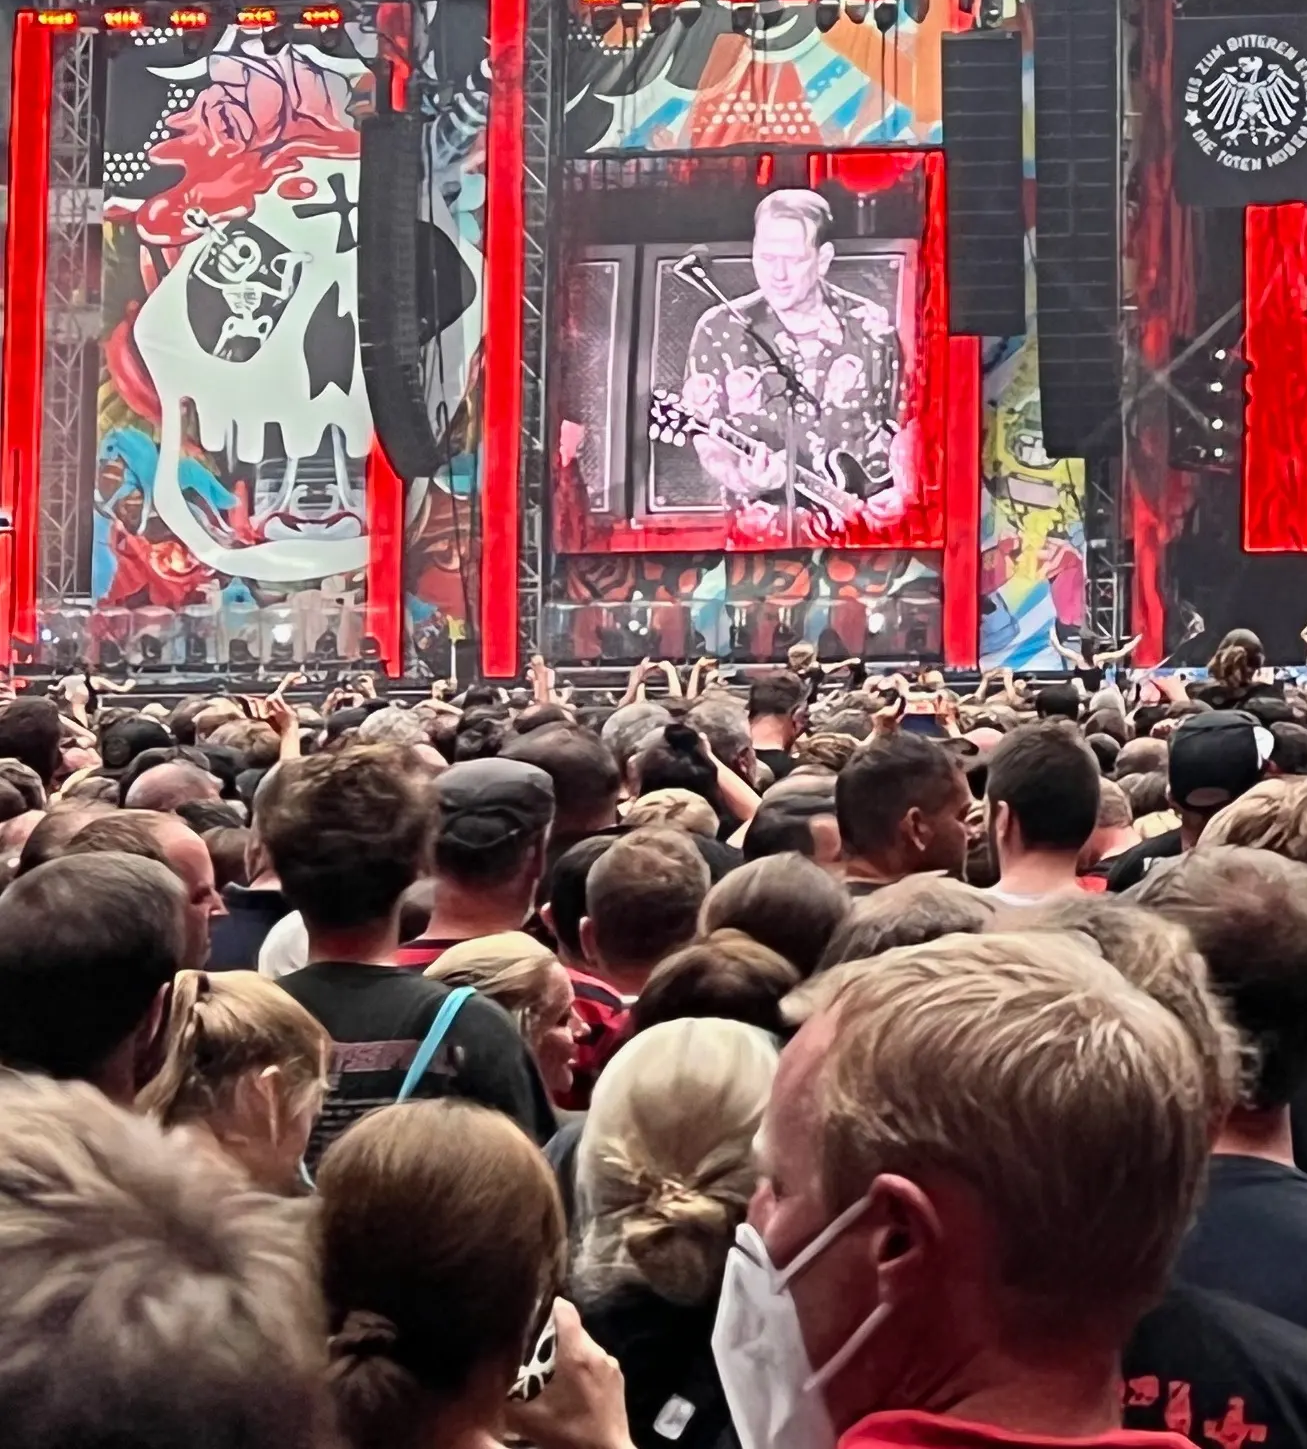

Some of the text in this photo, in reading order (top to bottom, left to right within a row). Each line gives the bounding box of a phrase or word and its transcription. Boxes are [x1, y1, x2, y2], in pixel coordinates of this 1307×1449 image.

[1195, 44, 1226, 75] ZUM
[1192, 129, 1218, 156] DIE
[1216, 150, 1262, 171] TOTEN
